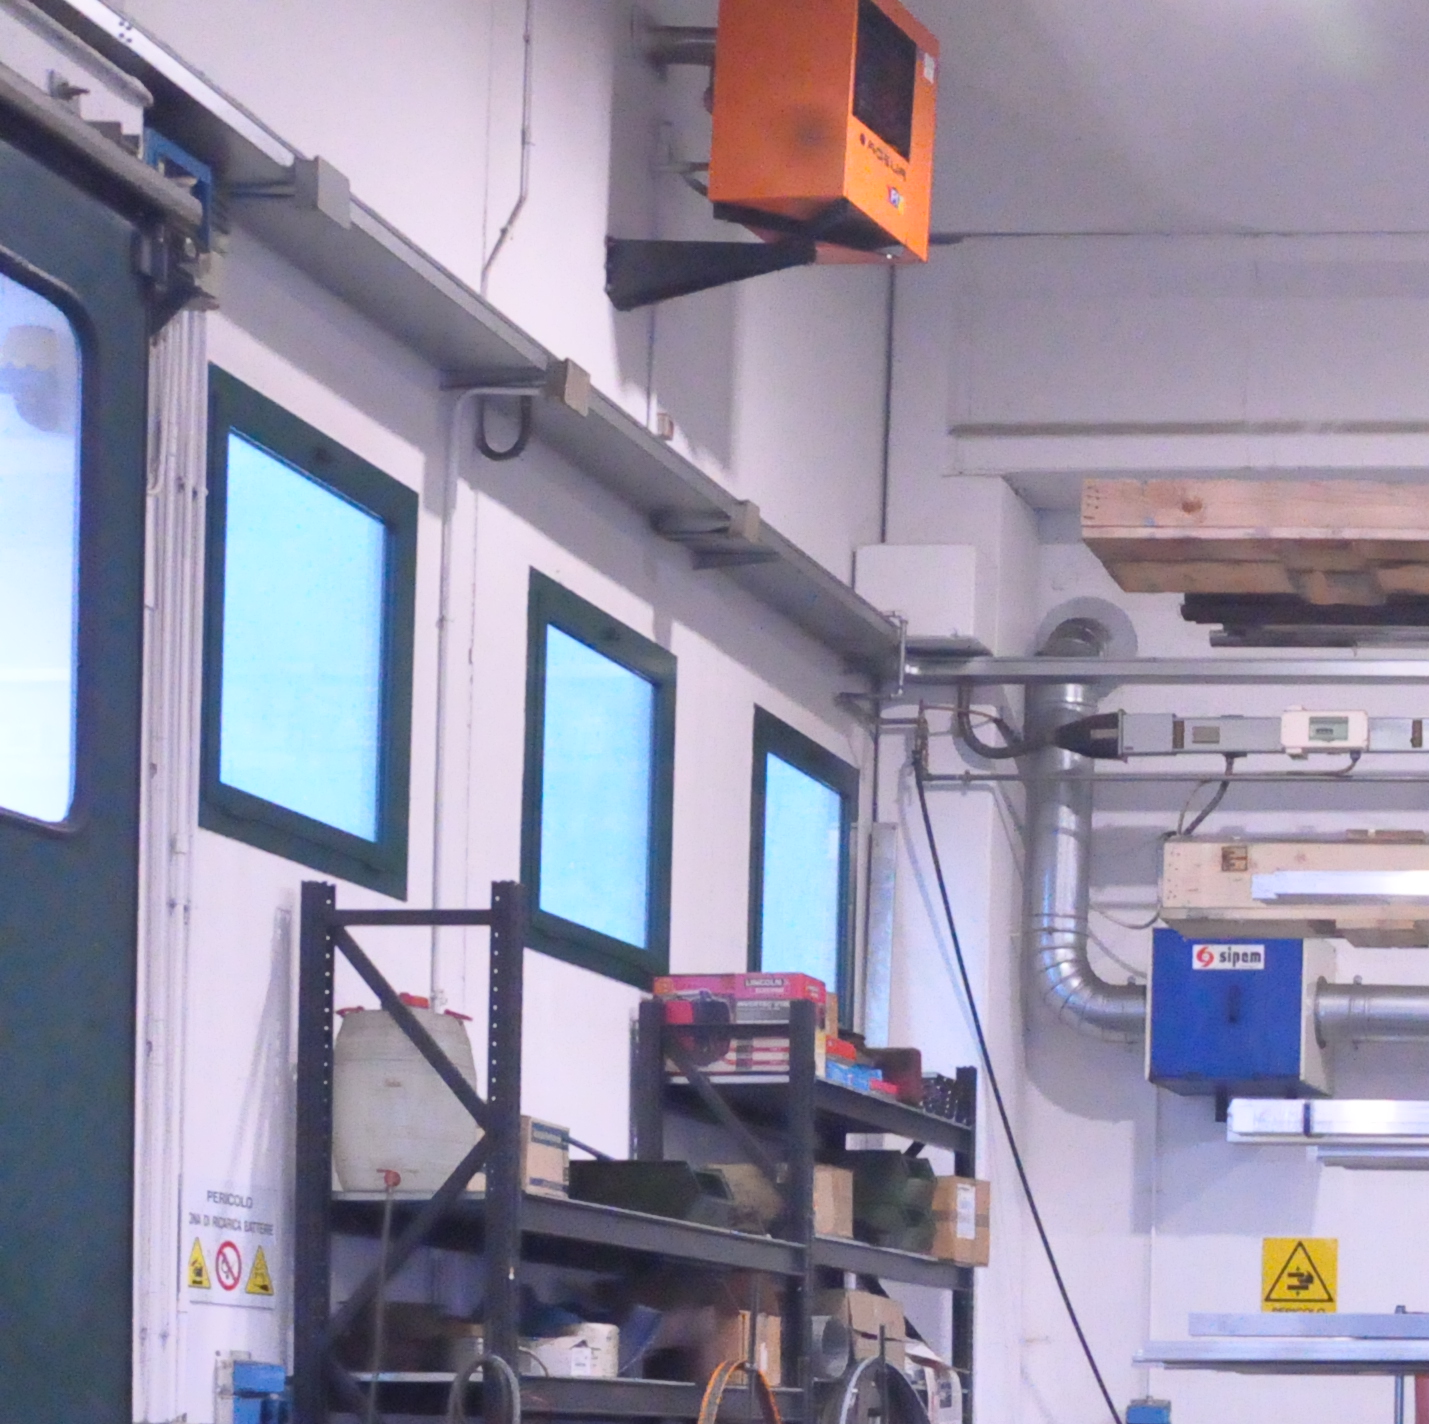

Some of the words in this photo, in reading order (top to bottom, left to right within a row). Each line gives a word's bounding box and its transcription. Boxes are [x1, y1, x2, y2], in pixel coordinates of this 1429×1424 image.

[1219, 946, 1262, 968] sipem
[745, 979, 783, 988] LINCOLN
[206, 1190, 253, 1209] PERICOLO
